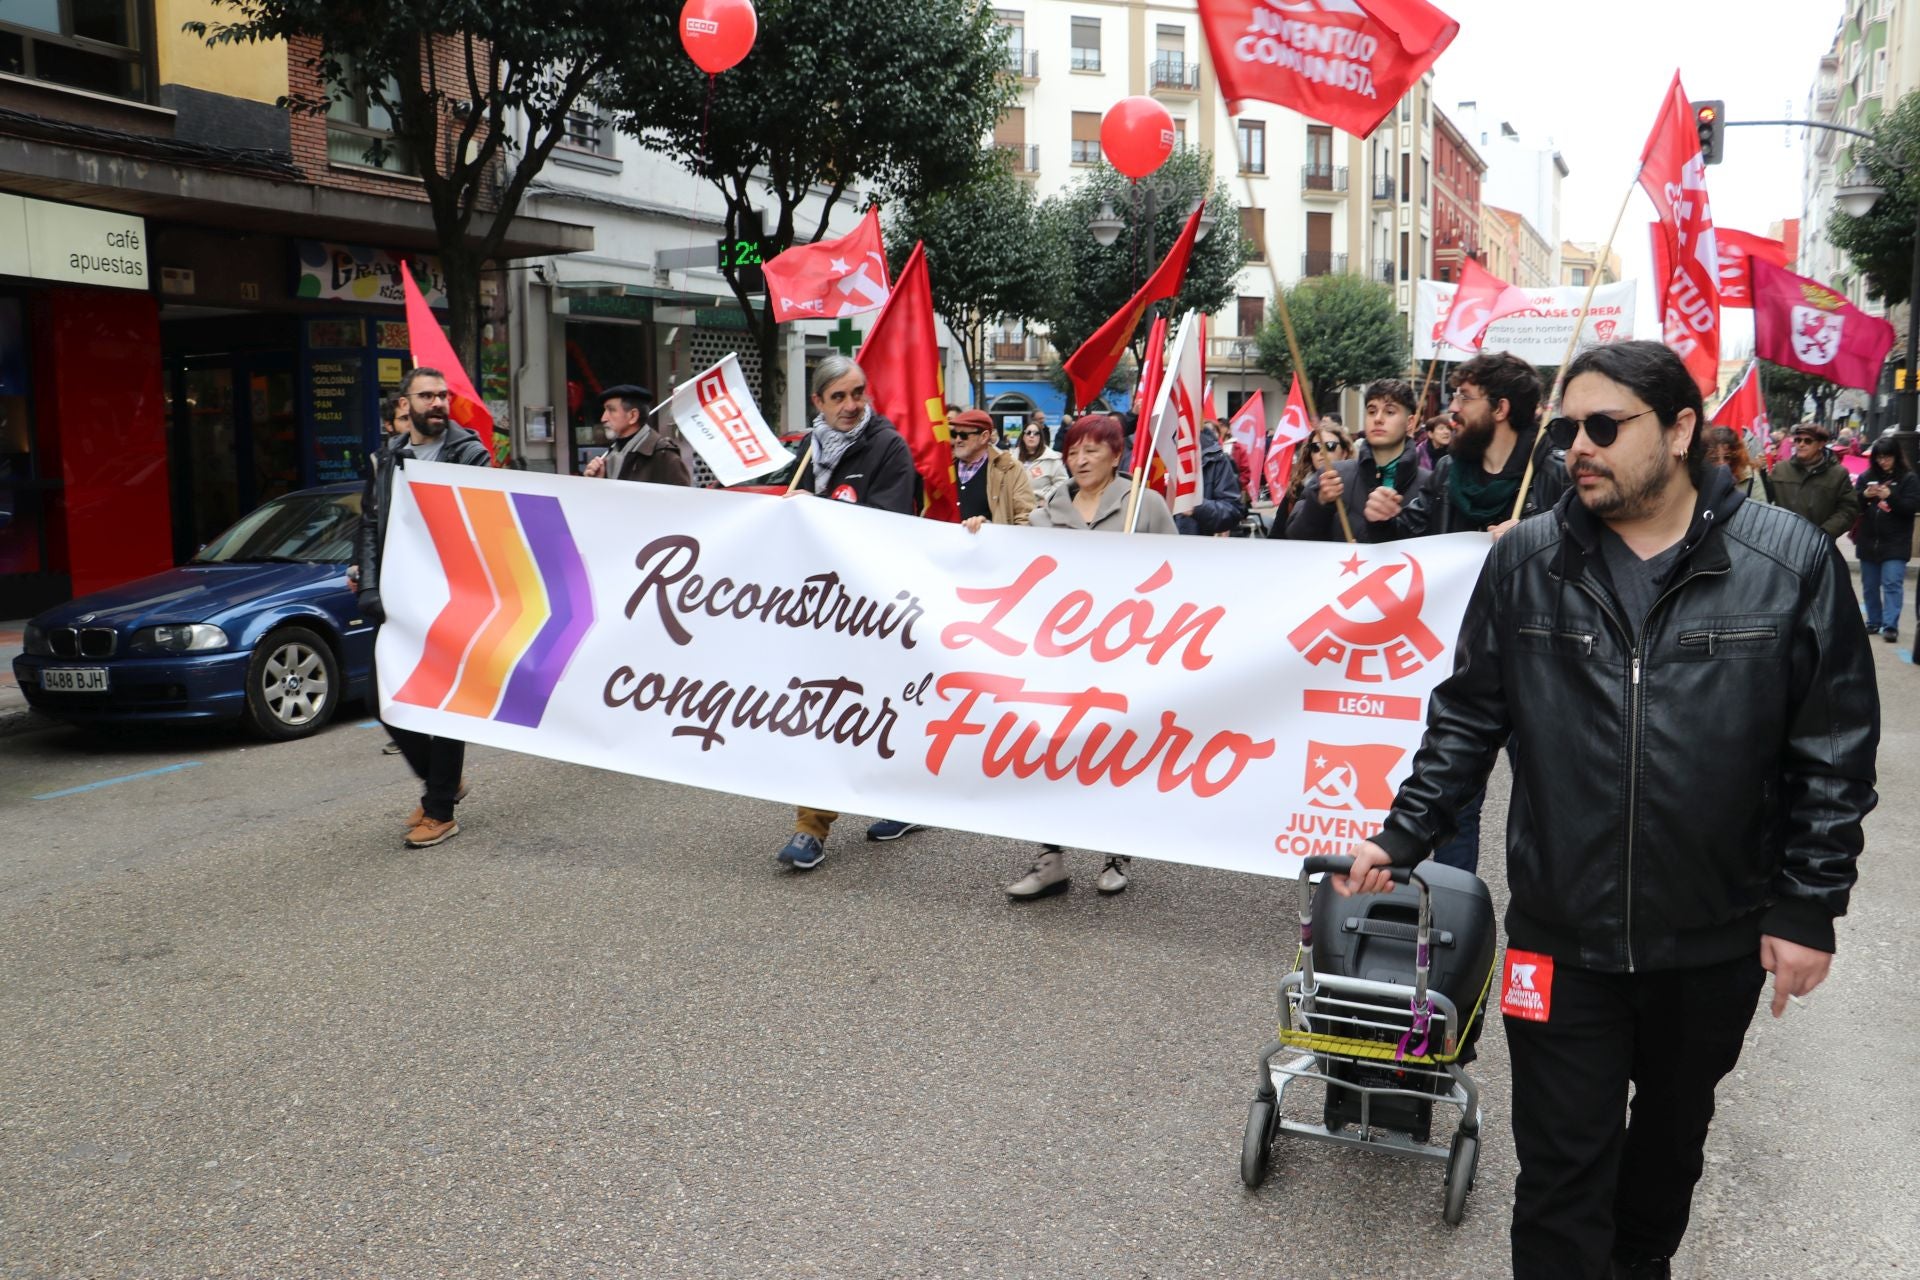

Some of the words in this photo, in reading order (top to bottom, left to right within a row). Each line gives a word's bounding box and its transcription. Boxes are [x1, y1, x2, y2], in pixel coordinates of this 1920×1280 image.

[687, 20, 716, 32] CCOO
[1235, 35, 1377, 99] COMUNISTA
[106, 230, 139, 250] café
[70, 253, 143, 275] apuestas
[1571, 306, 1622, 317] ORERA
[1669, 266, 1715, 333] TUD
[690, 413, 715, 440] León
[699, 371, 768, 464] CCOO
[625, 535, 925, 649] Reconstruir
[940, 555, 1227, 671] León
[1304, 636, 1424, 682] PCE
[45, 672, 73, 688] 9488
[76, 672, 104, 688] BJH
[1338, 696, 1385, 716] LEÓN
[604, 665, 899, 759] conquistar
[902, 672, 933, 706] el
[925, 671, 1276, 798] Futuro
[1286, 813, 1384, 841] JUVENT
[1275, 834, 1354, 857] COMU
